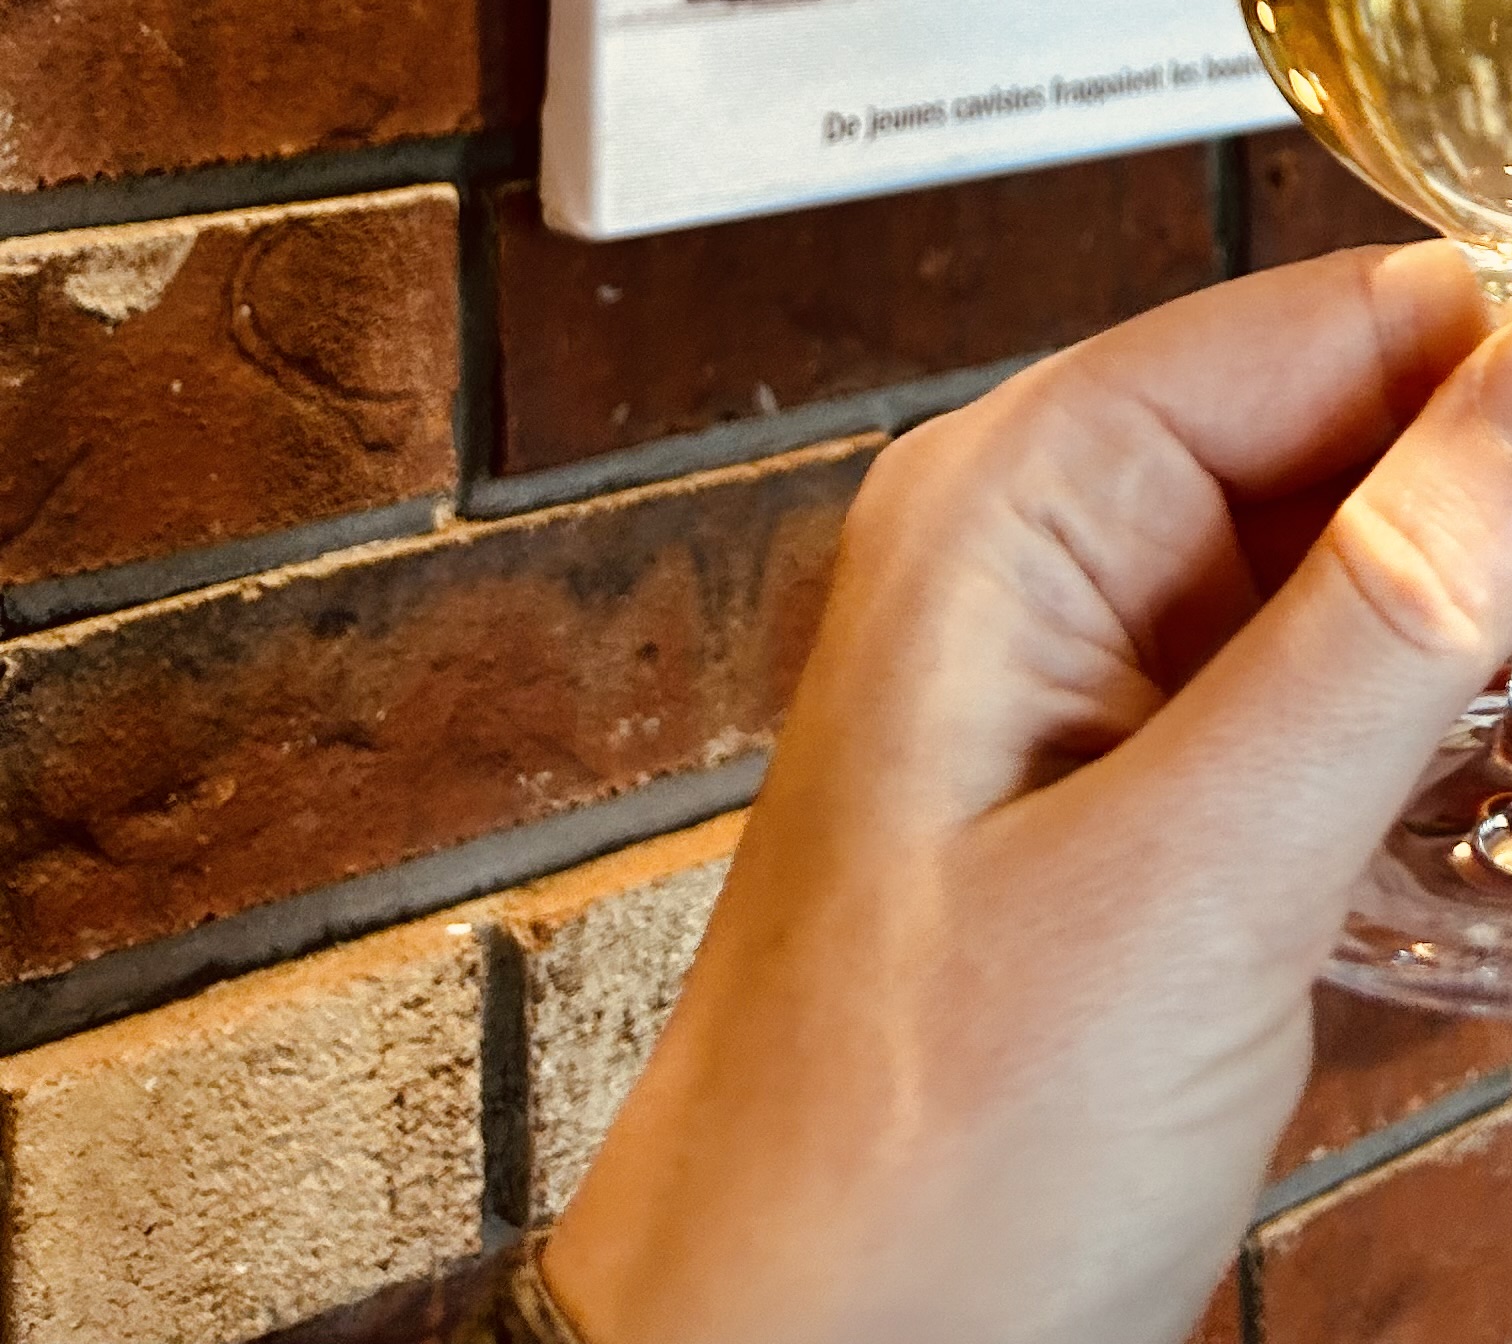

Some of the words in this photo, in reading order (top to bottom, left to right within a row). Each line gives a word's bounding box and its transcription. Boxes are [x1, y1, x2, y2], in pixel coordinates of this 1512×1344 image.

[823, 110, 862, 143] De
[864, 98, 947, 143] jeunes
[953, 82, 1046, 125] cavistes
